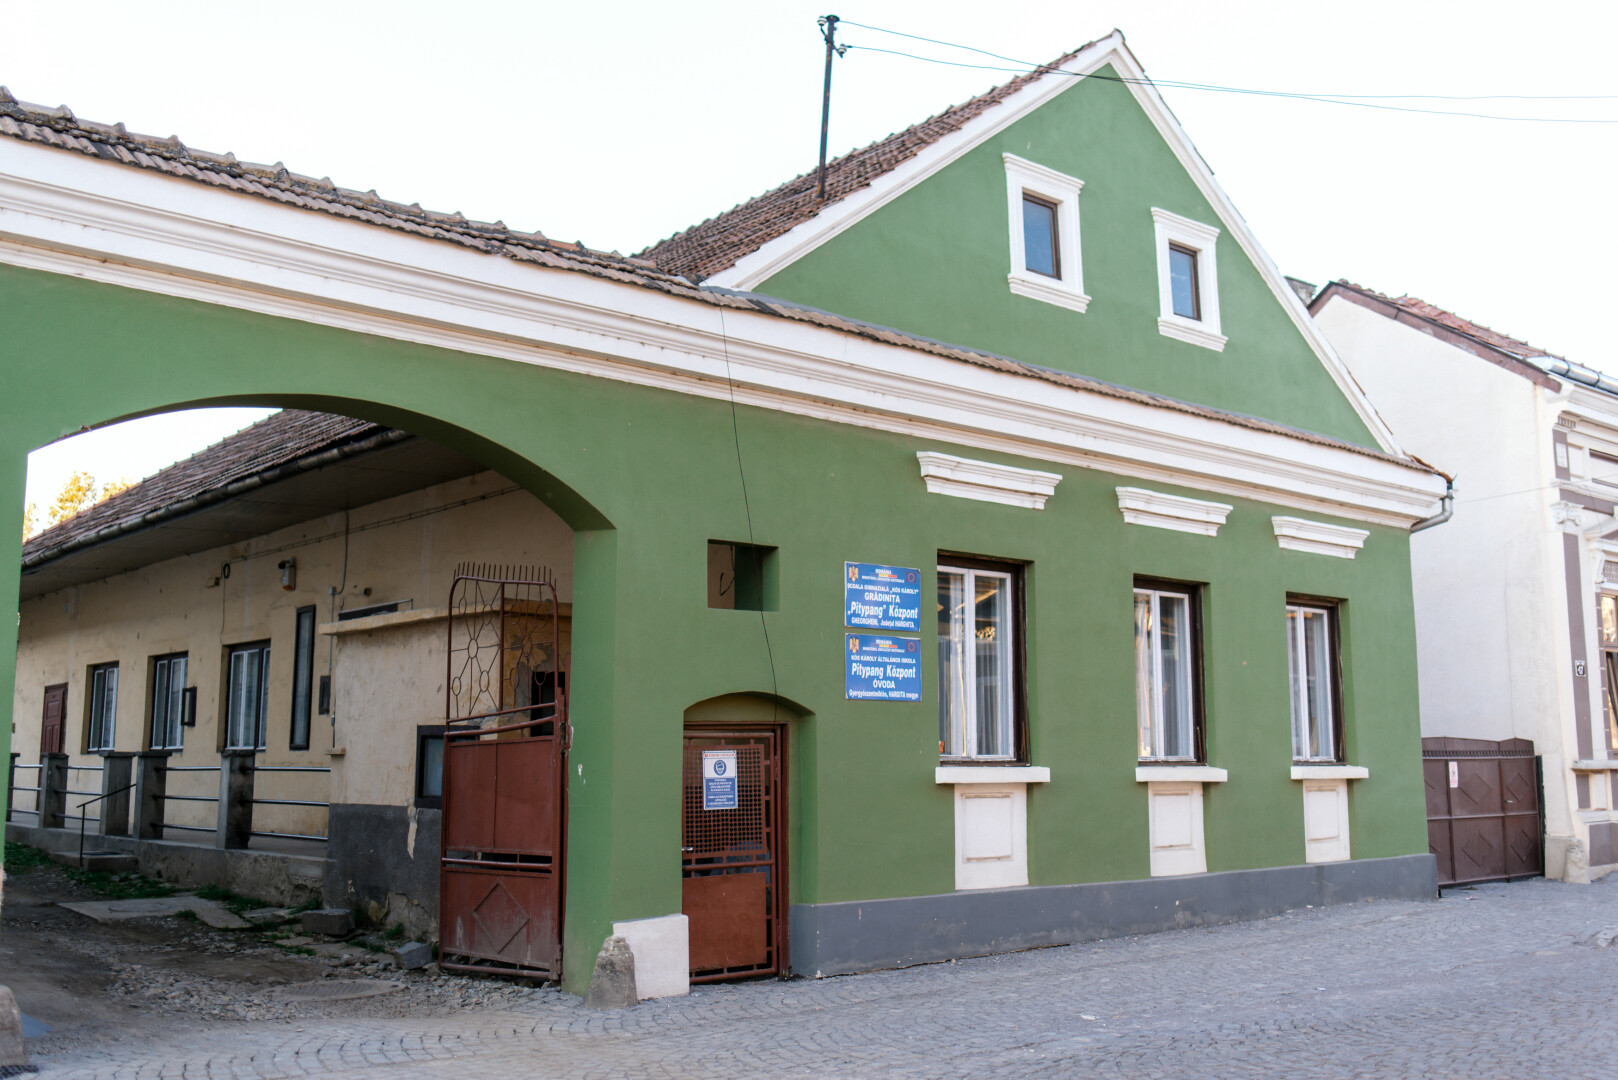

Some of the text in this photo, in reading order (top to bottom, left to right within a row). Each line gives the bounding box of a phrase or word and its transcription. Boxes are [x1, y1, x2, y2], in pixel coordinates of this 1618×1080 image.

[889, 604, 918, 620] Központ
[852, 662, 916, 680] Pitypang Központ
[873, 678, 896, 689] ÓVODA
